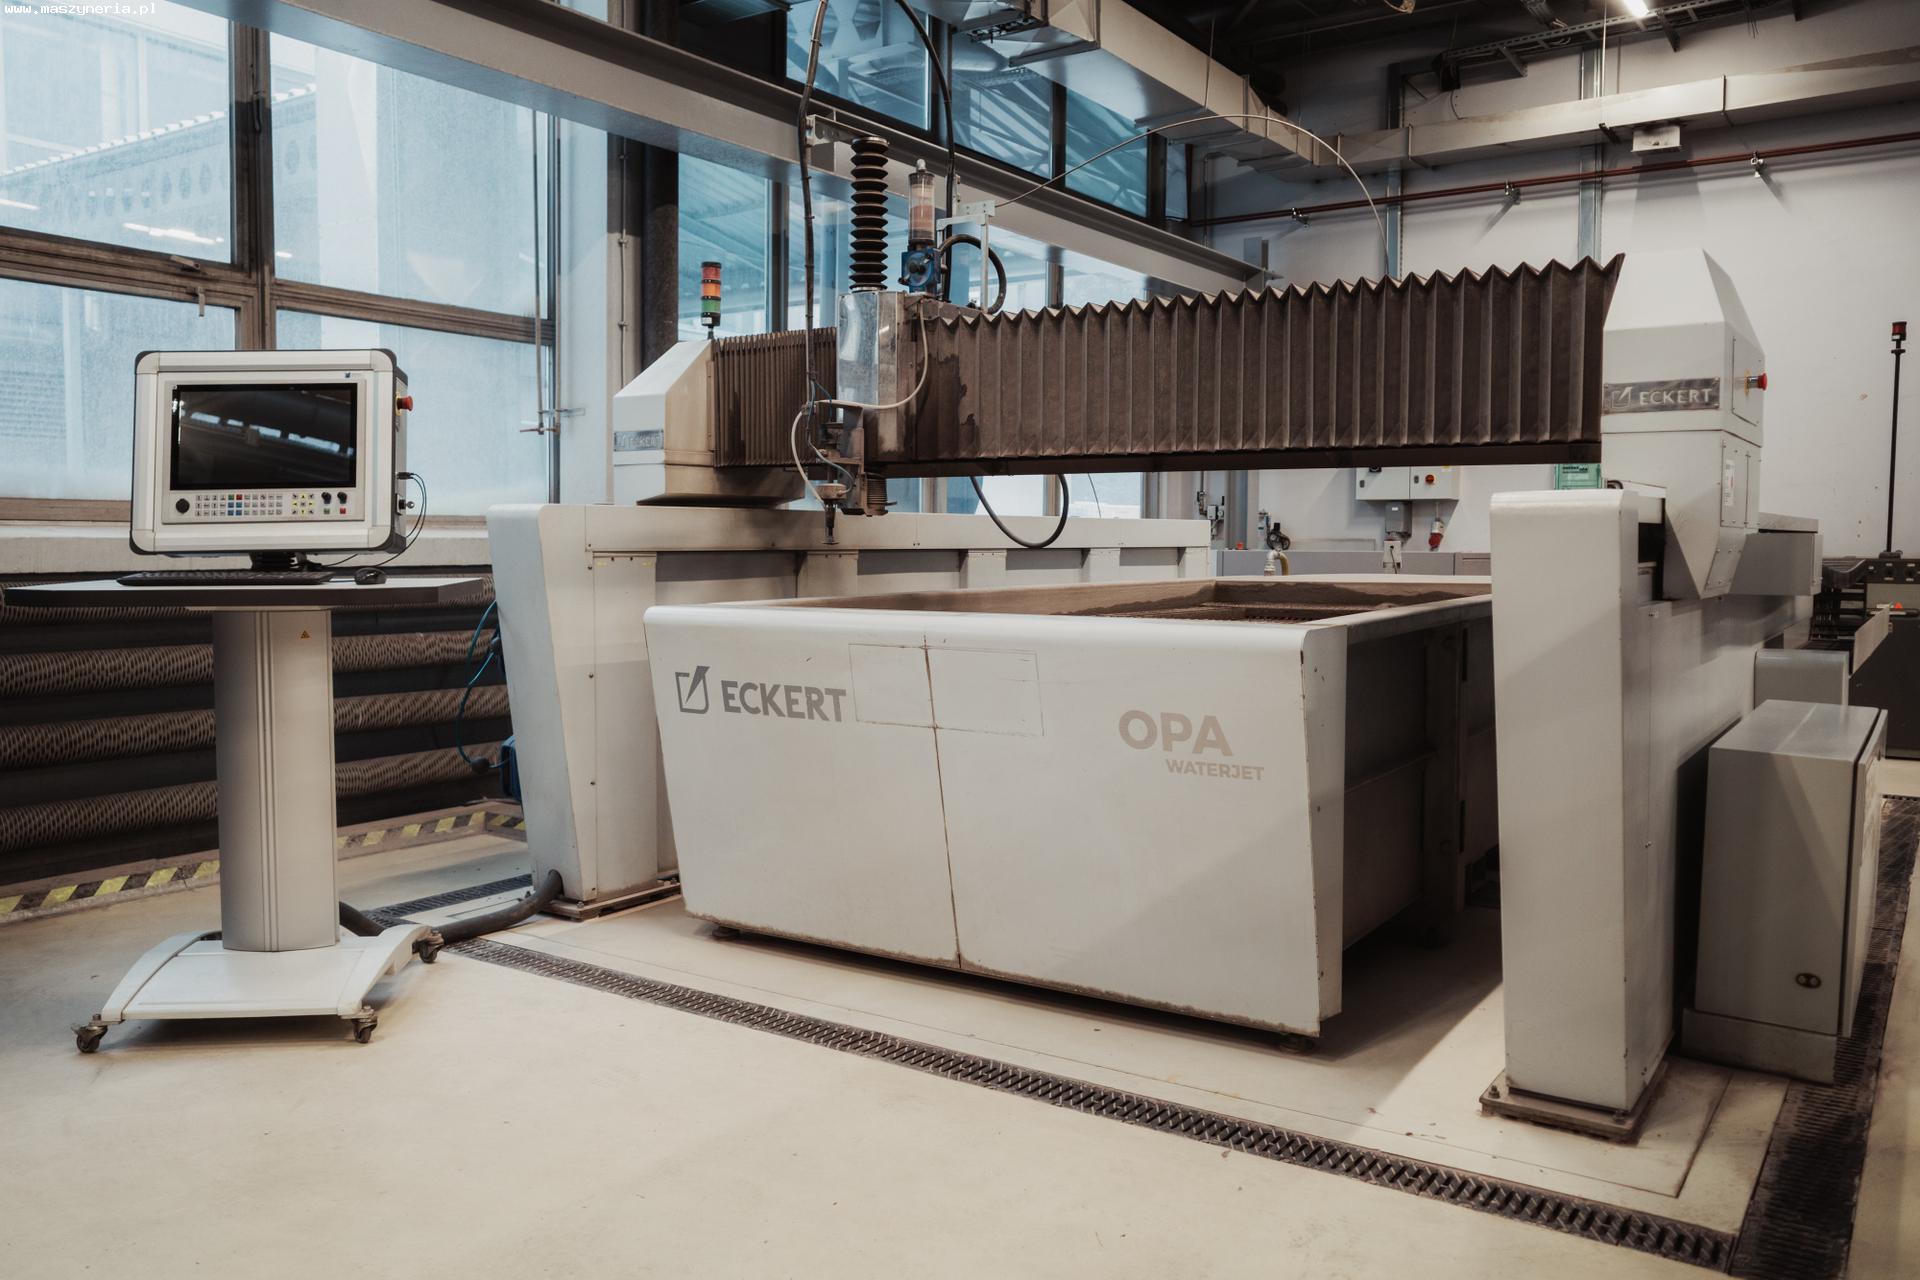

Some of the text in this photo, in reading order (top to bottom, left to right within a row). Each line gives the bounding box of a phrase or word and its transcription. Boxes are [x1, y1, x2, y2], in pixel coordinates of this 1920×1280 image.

[1639, 388, 1713, 405] ECKERT
[720, 680, 847, 722] ECKERT
[1119, 710, 1234, 757] OPA
[1165, 758, 1265, 781] WATERJET
